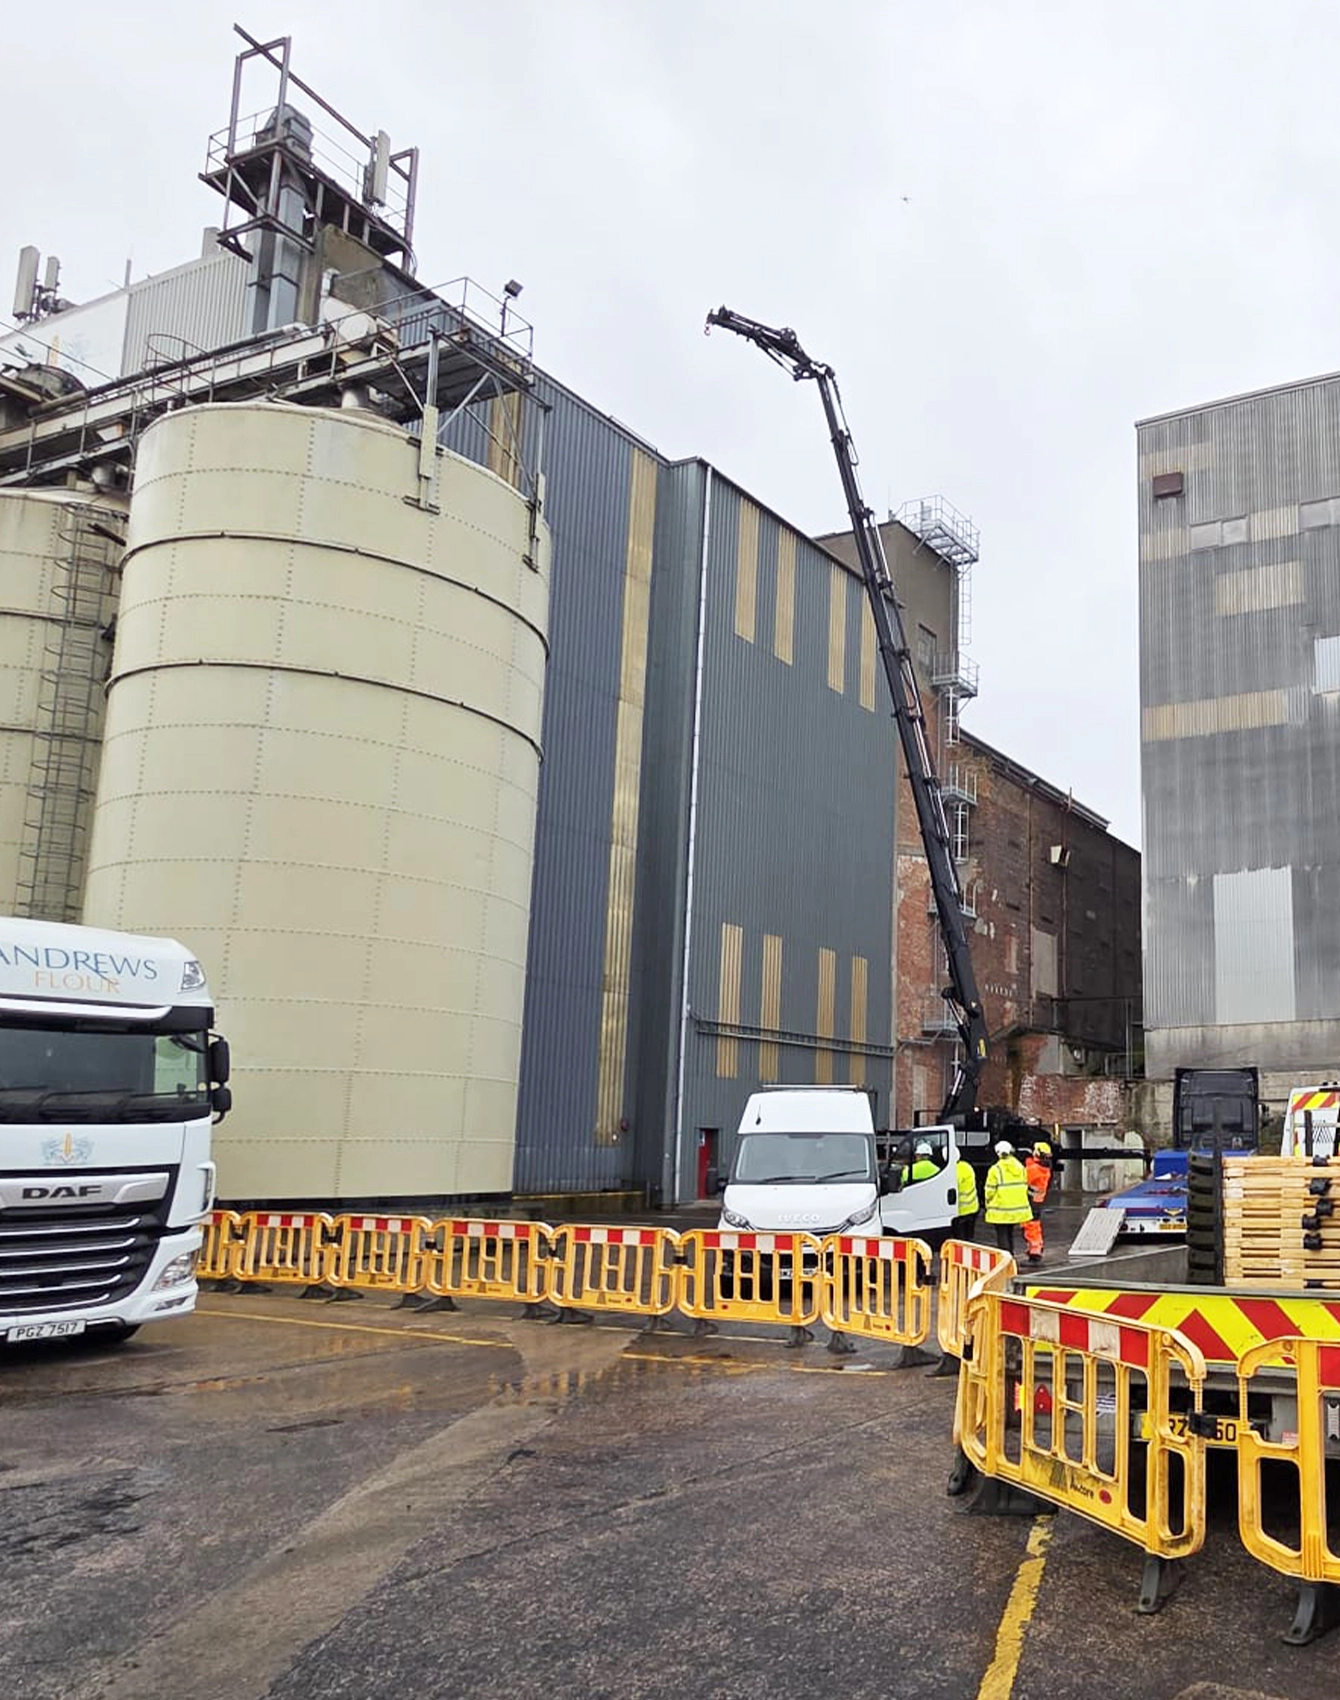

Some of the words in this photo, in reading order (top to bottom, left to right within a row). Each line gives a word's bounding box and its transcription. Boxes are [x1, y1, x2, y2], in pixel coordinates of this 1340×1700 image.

[34, 971, 120, 993] FLOUR
[22, 1185, 102, 1200] DAF
[778, 1212, 821, 1224] IVECO
[16, 1326, 44, 1338] PGZ
[49, 1322, 77, 1336] 7517
